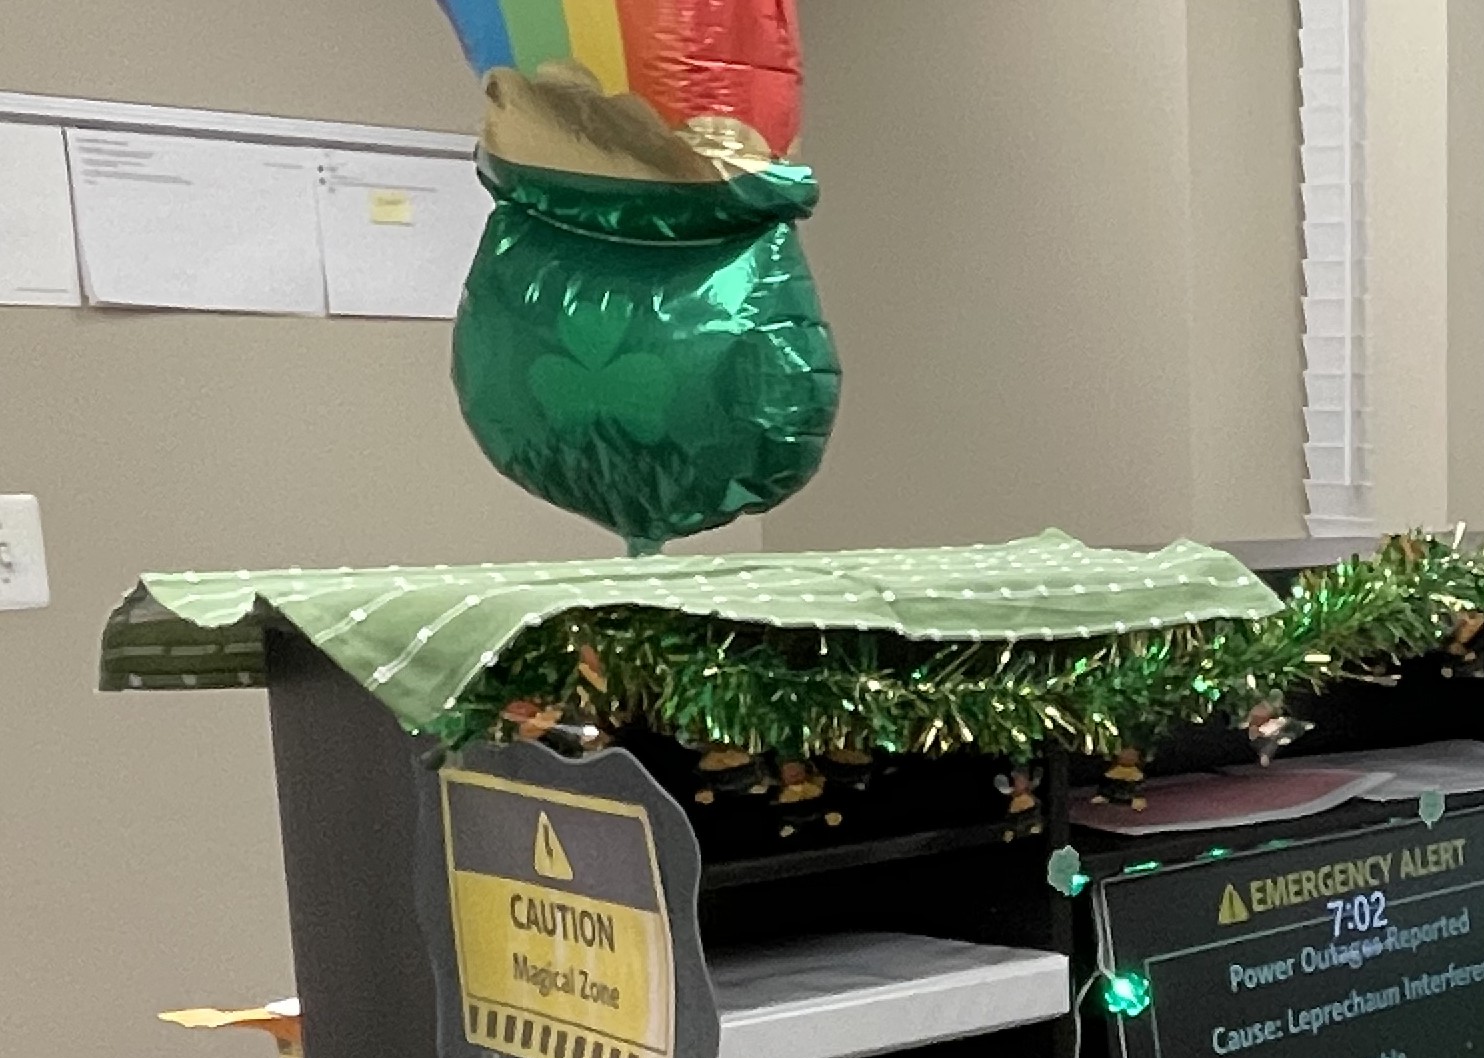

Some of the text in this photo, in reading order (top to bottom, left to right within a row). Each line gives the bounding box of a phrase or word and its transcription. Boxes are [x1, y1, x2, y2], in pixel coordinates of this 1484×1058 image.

[1250, 838, 1467, 912] EMERGENCY ALERT
[510, 893, 615, 953] CAUTION
[1326, 890, 1389, 938] 7:02
[512, 951, 620, 1010] Magical Zone
[1229, 953, 1296, 994] Power
[1385, 907, 1471, 952] Reported
[1211, 1016, 1284, 1056] Cause:
[1287, 984, 1401, 1036] Leprechaun
